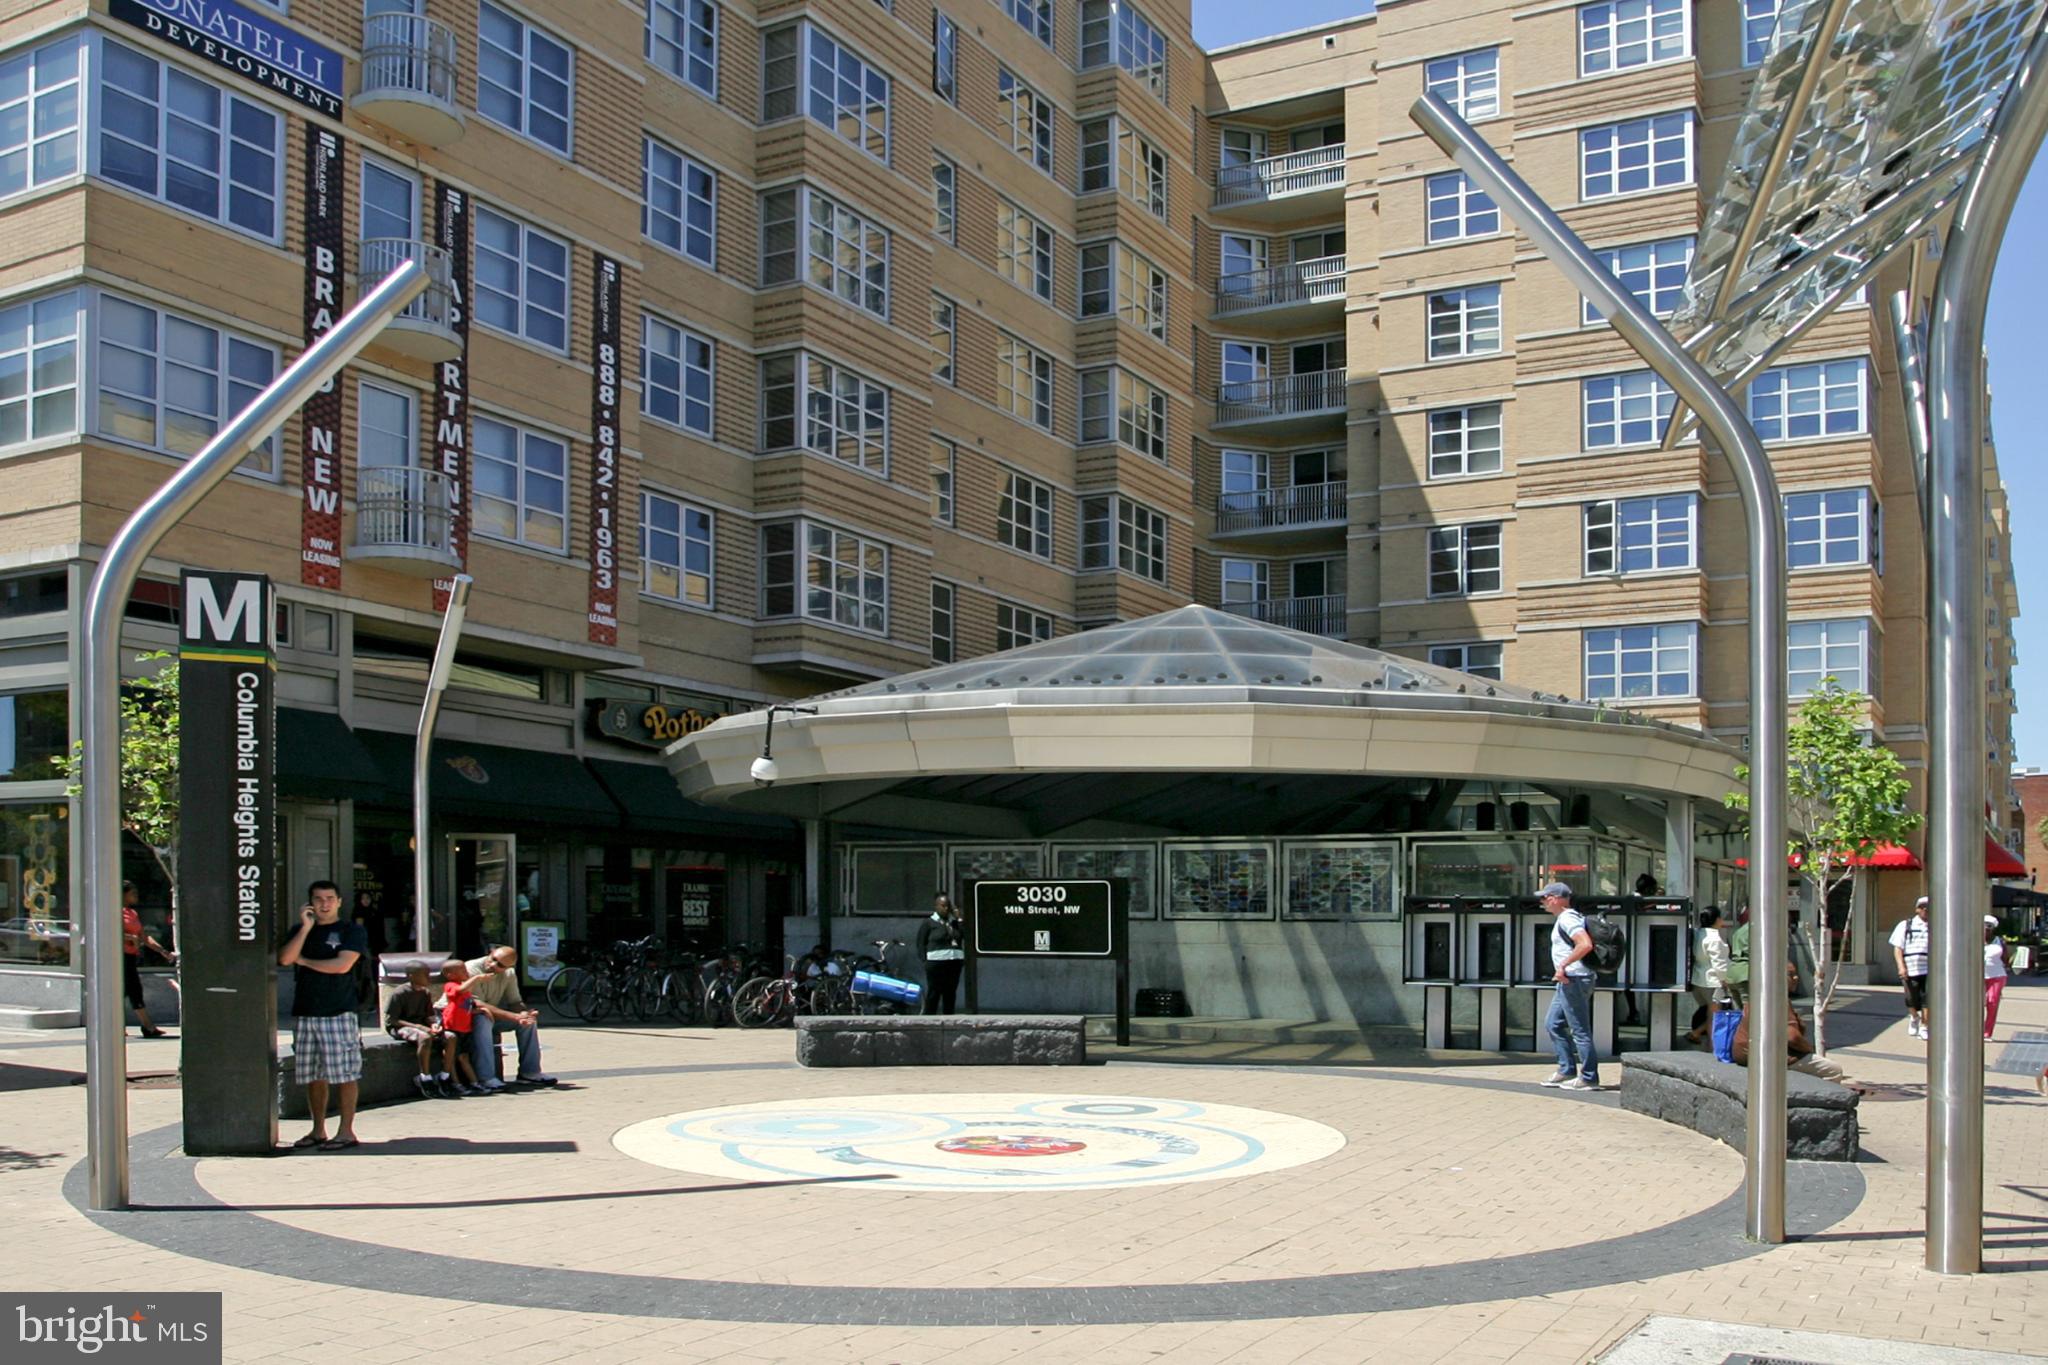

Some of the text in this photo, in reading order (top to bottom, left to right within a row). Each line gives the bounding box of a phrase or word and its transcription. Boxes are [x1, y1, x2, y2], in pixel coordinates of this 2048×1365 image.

[146, 12, 339, 114] DEVELOPMENT
[312, 245, 335, 393] BRA
[307, 426, 338, 515] NEW
[303, 550, 340, 568] LEASING
[310, 537, 333, 551] NOW
[186, 576, 261, 643] M
[233, 672, 261, 941] Columbia Heights Station
[683, 900, 710, 916] BEST
[1003, 905, 1080, 916] 14th Street, NW
[1016, 886, 1067, 902] 3030
